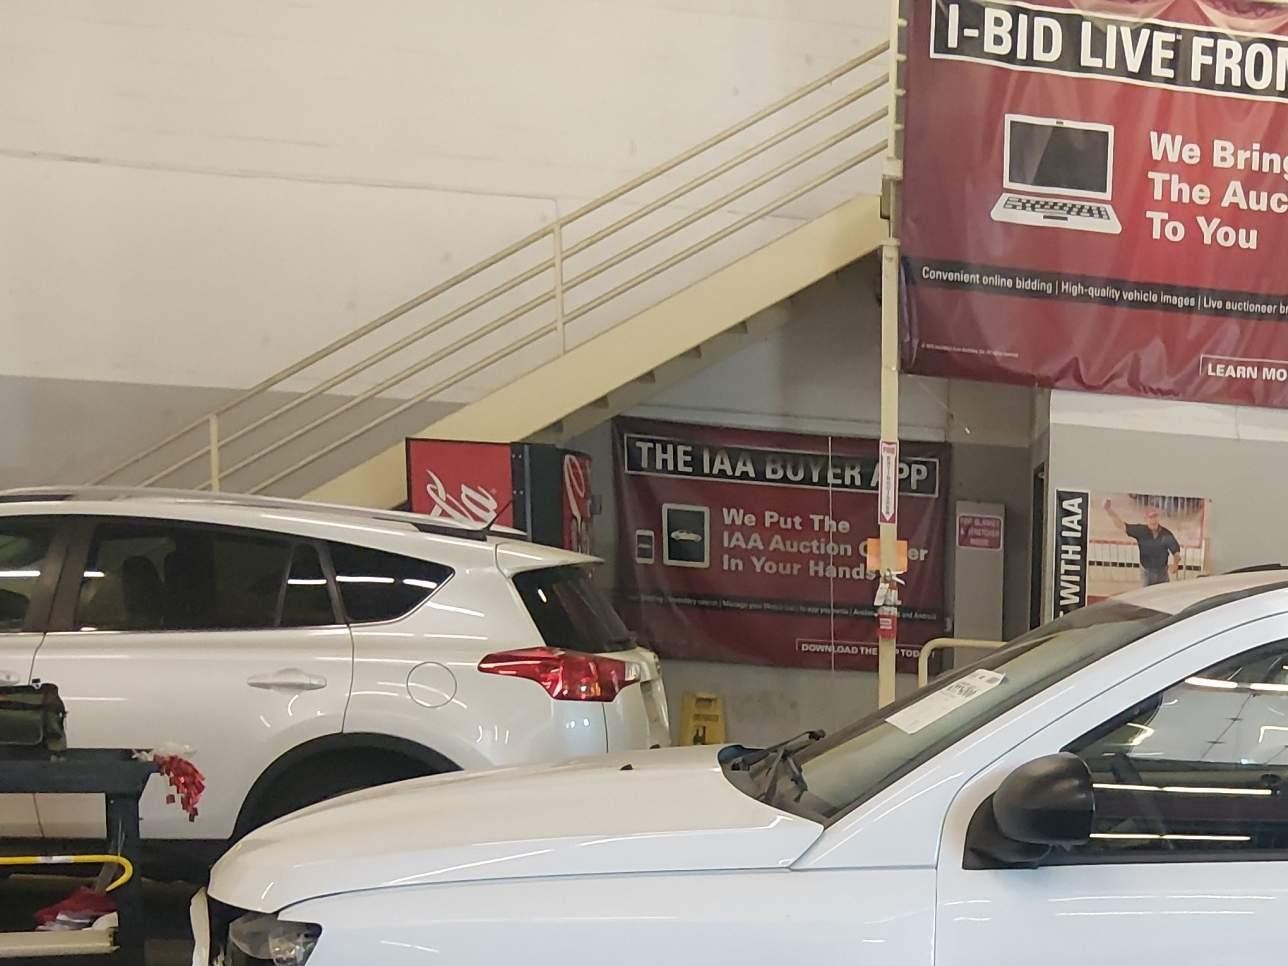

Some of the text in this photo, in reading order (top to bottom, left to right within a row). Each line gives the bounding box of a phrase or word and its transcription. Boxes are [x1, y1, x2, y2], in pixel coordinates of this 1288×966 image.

[948, 4, 1062, 62] I-BID
[1150, 131, 1200, 164] We
[1148, 171, 1211, 205] The
[1146, 211, 1258, 250] To You
[922, 266, 980, 284] Convenient
[982, 274, 1013, 289] online
[1016, 276, 1052, 294] bidding
[1061, 281, 1121, 301] High-quality
[1122, 289, 1158, 304] vehicle
[1160, 292, 1195, 309] images
[1203, 295, 1223, 309] Live
[1225, 298, 1278, 314] auctioneer
[1208, 363, 1257, 379] LEARN
[635, 441, 693, 473] THE
[703, 448, 756, 478] IAA
[765, 456, 862, 487] BUYER
[722, 507, 850, 533] We Put The
[722, 531, 764, 550] IAA
[769, 534, 852, 556] Auction
[1059, 497, 1083, 606] WITH IAA
[722, 554, 876, 580] In Your Hands
[801, 643, 859, 655] DOWNLOAD
[860, 646, 878, 656] THE
